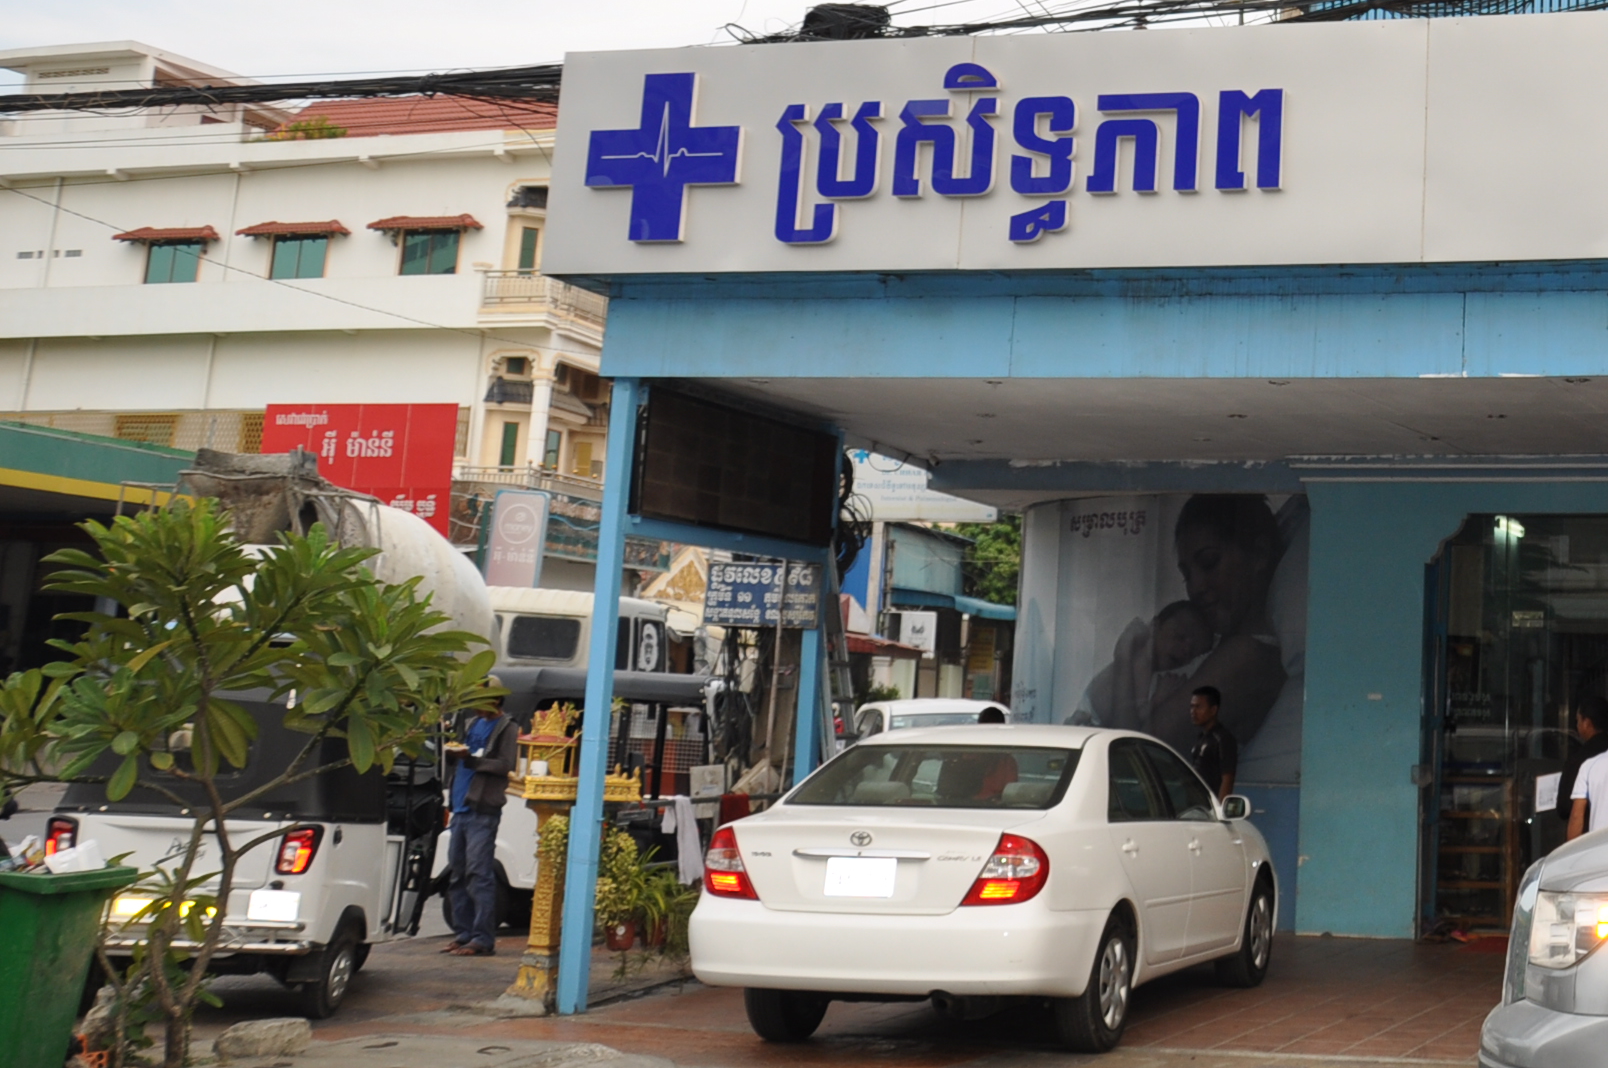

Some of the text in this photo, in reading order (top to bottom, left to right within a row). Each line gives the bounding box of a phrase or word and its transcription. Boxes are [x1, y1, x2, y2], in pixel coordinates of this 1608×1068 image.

[775, 62, 1286, 245] ប្រសិទ្ធភាព
